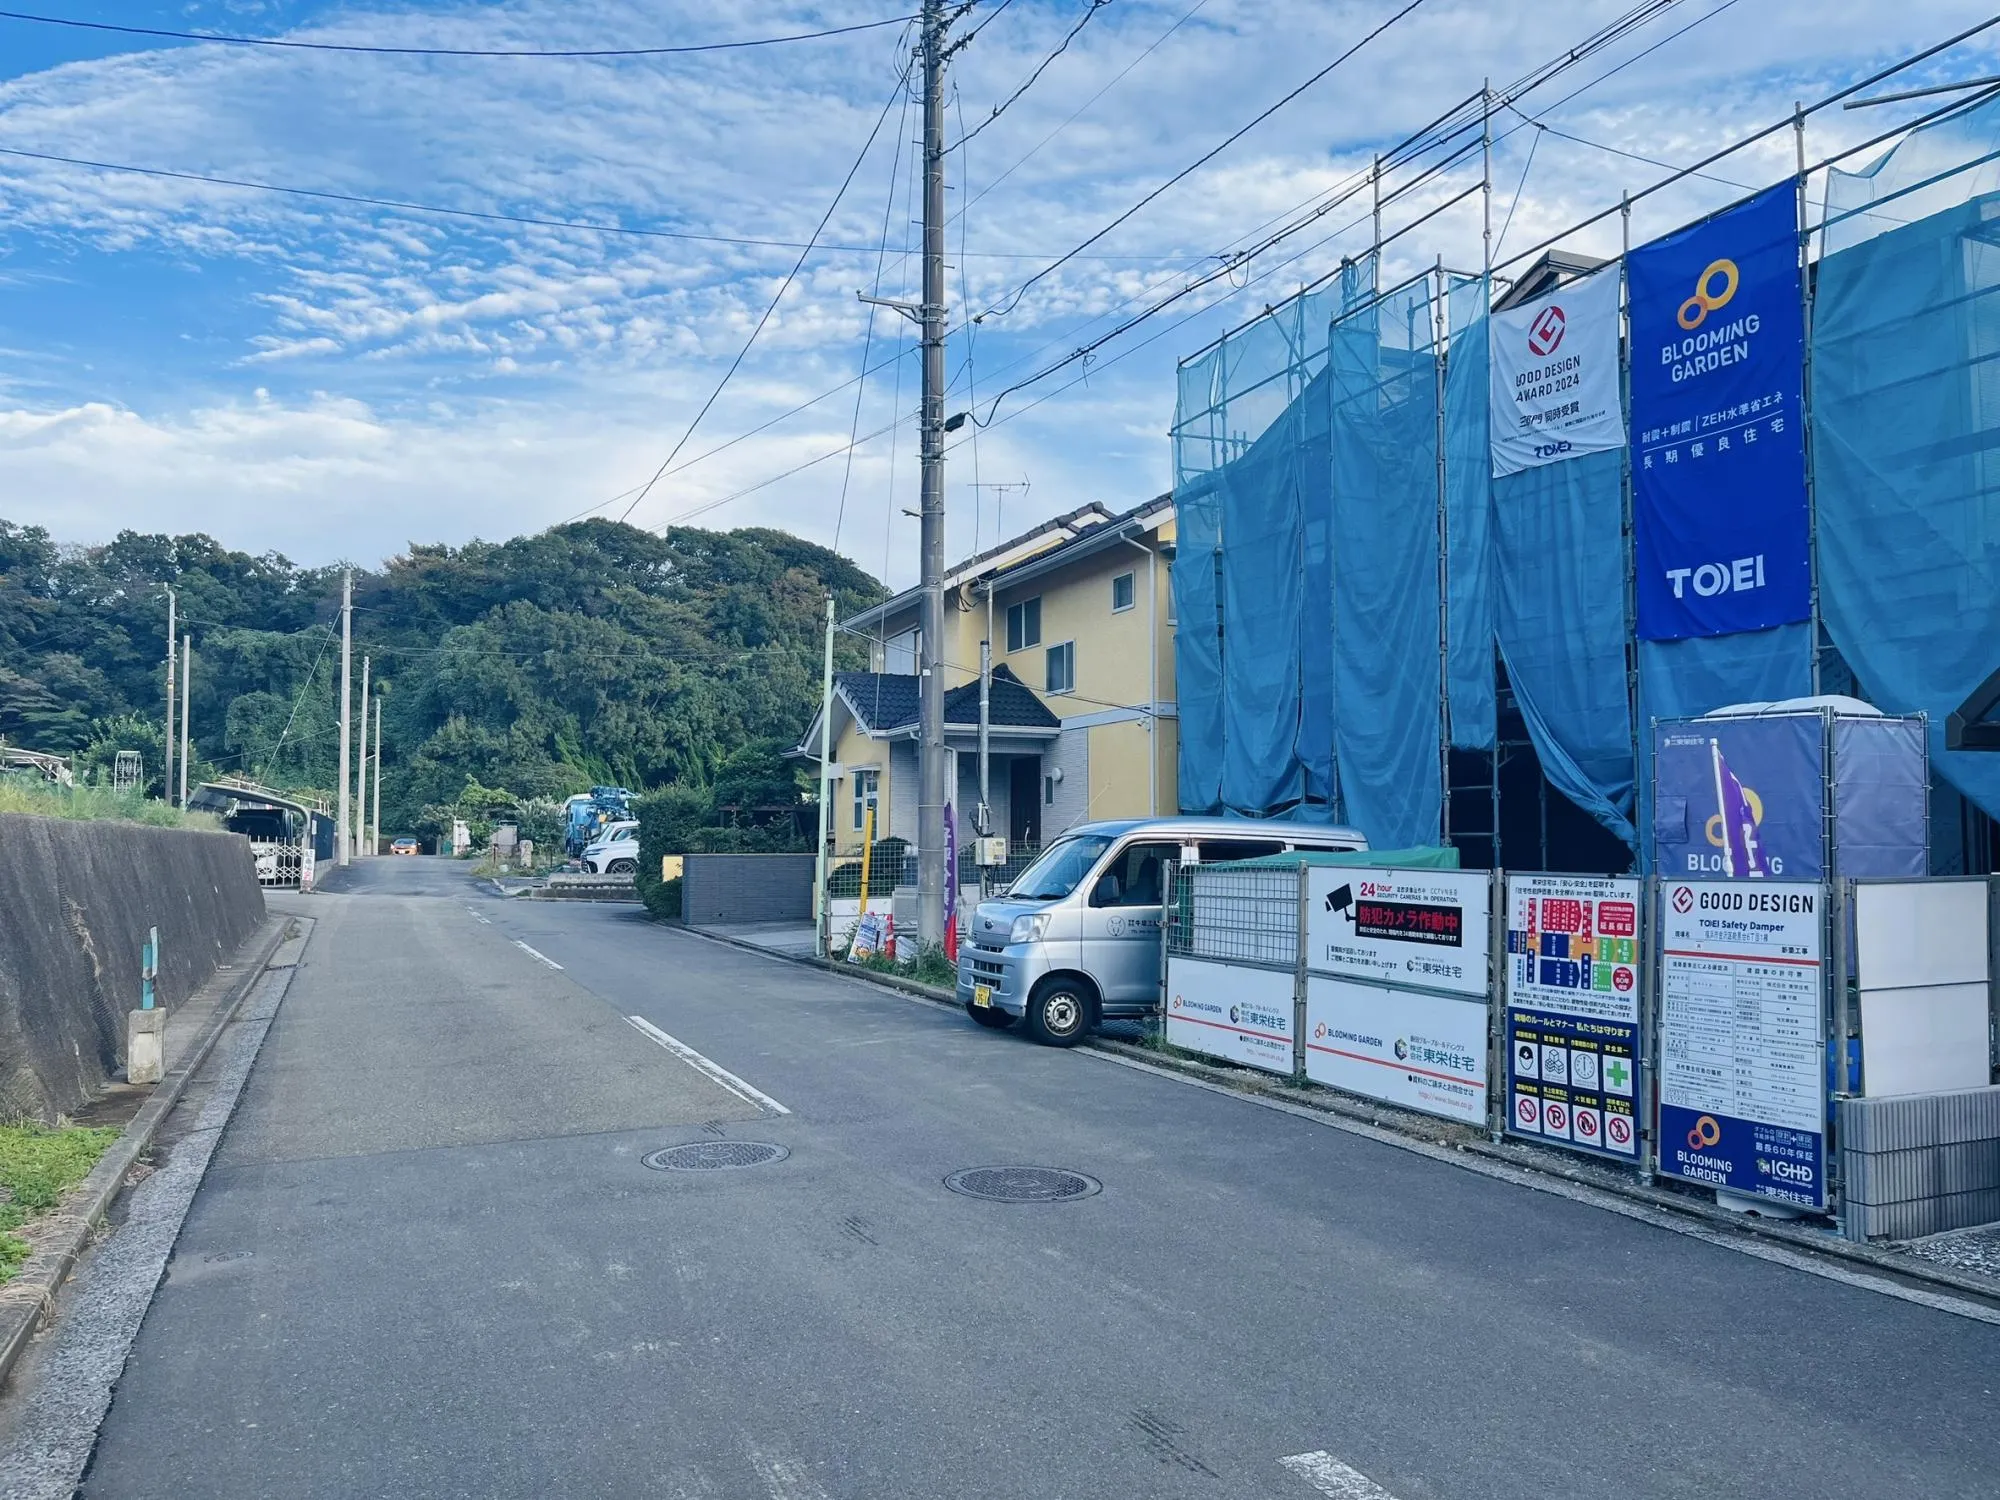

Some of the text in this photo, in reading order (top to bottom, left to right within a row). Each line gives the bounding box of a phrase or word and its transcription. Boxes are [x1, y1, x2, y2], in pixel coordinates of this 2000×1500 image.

[1661, 314, 1760, 365] BLOOMING
[1544, 355, 1580, 379] DESIGN
[1671, 340, 1748, 383] GARDEN
[1515, 373, 1579, 402] AWARD 2024
[1544, 400, 1579, 422] 同時受賞
[1702, 391, 1783, 428] ZEH水準省エネ
[1643, 418, 1784, 470] 長期優良住宅
[1360, 882, 1392, 897] 24 hour
[1399, 893, 1421, 901] CAMERAS
[1430, 895, 1458, 903] OPERATION
[1700, 892, 1813, 913] GOOD DESIGN
[1359, 905, 1458, 932] 防犯カメラ作動中
[1721, 920, 1747, 932] Safety
[1750, 921, 1784, 932] Damper
[1422, 963, 1462, 979] 東栄住宅
[1204, 1003, 1222, 1013] GARDEN
[1250, 1012, 1286, 1030] 東栄住宅
[1513, 1013, 1631, 1038] 現場のルールとマナー 私たちは守ります
[1327, 1028, 1383, 1048] BLOOMING GARDEN
[1423, 1048, 1475, 1072] 東栄住宅
[1677, 1150, 1732, 1173] BLOOMING
[1755, 1141, 1814, 1161] 最長60年保証
[1683, 1164, 1727, 1185] GARDEN
[1771, 1160, 1813, 1182] IGHD
[1765, 1186, 1814, 1206] 東栄住宅
